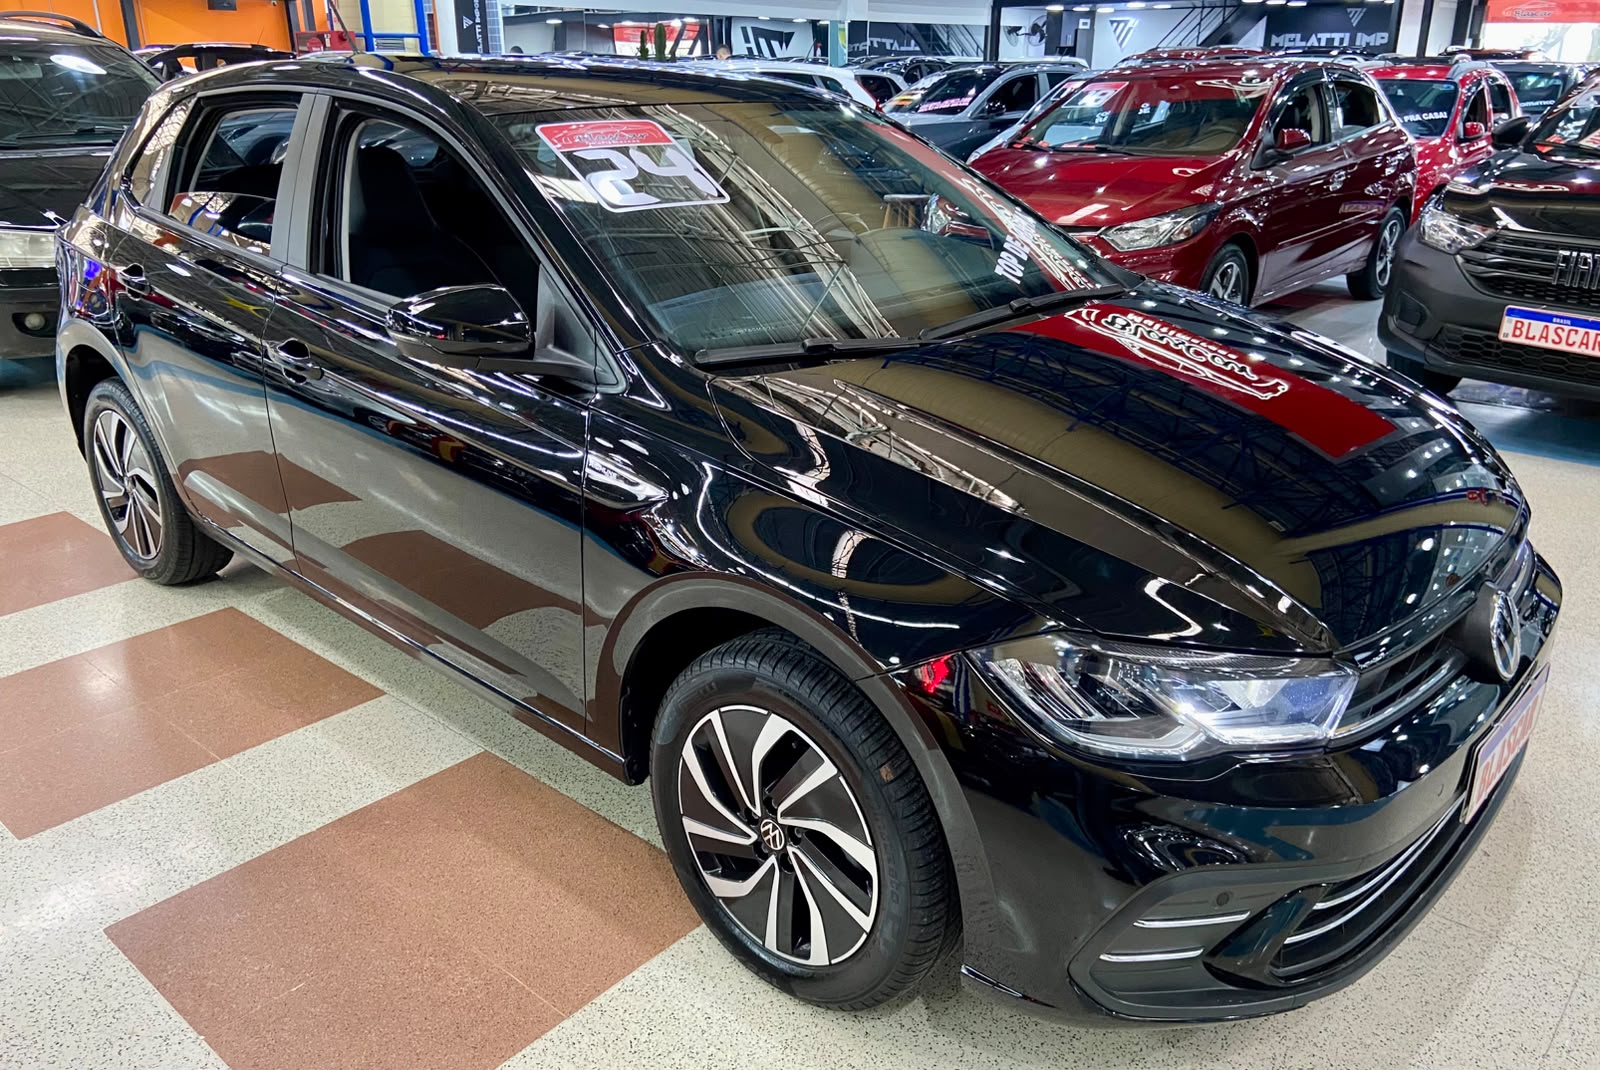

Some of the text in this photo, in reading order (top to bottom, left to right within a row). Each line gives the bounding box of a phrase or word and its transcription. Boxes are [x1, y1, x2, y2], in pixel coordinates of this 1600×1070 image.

[1270, 32, 1389, 47] MELATTI IMP
[1404, 115, 1422, 123] PRA
[573, 149, 718, 206] 24
[994, 251, 1025, 285] TOP
